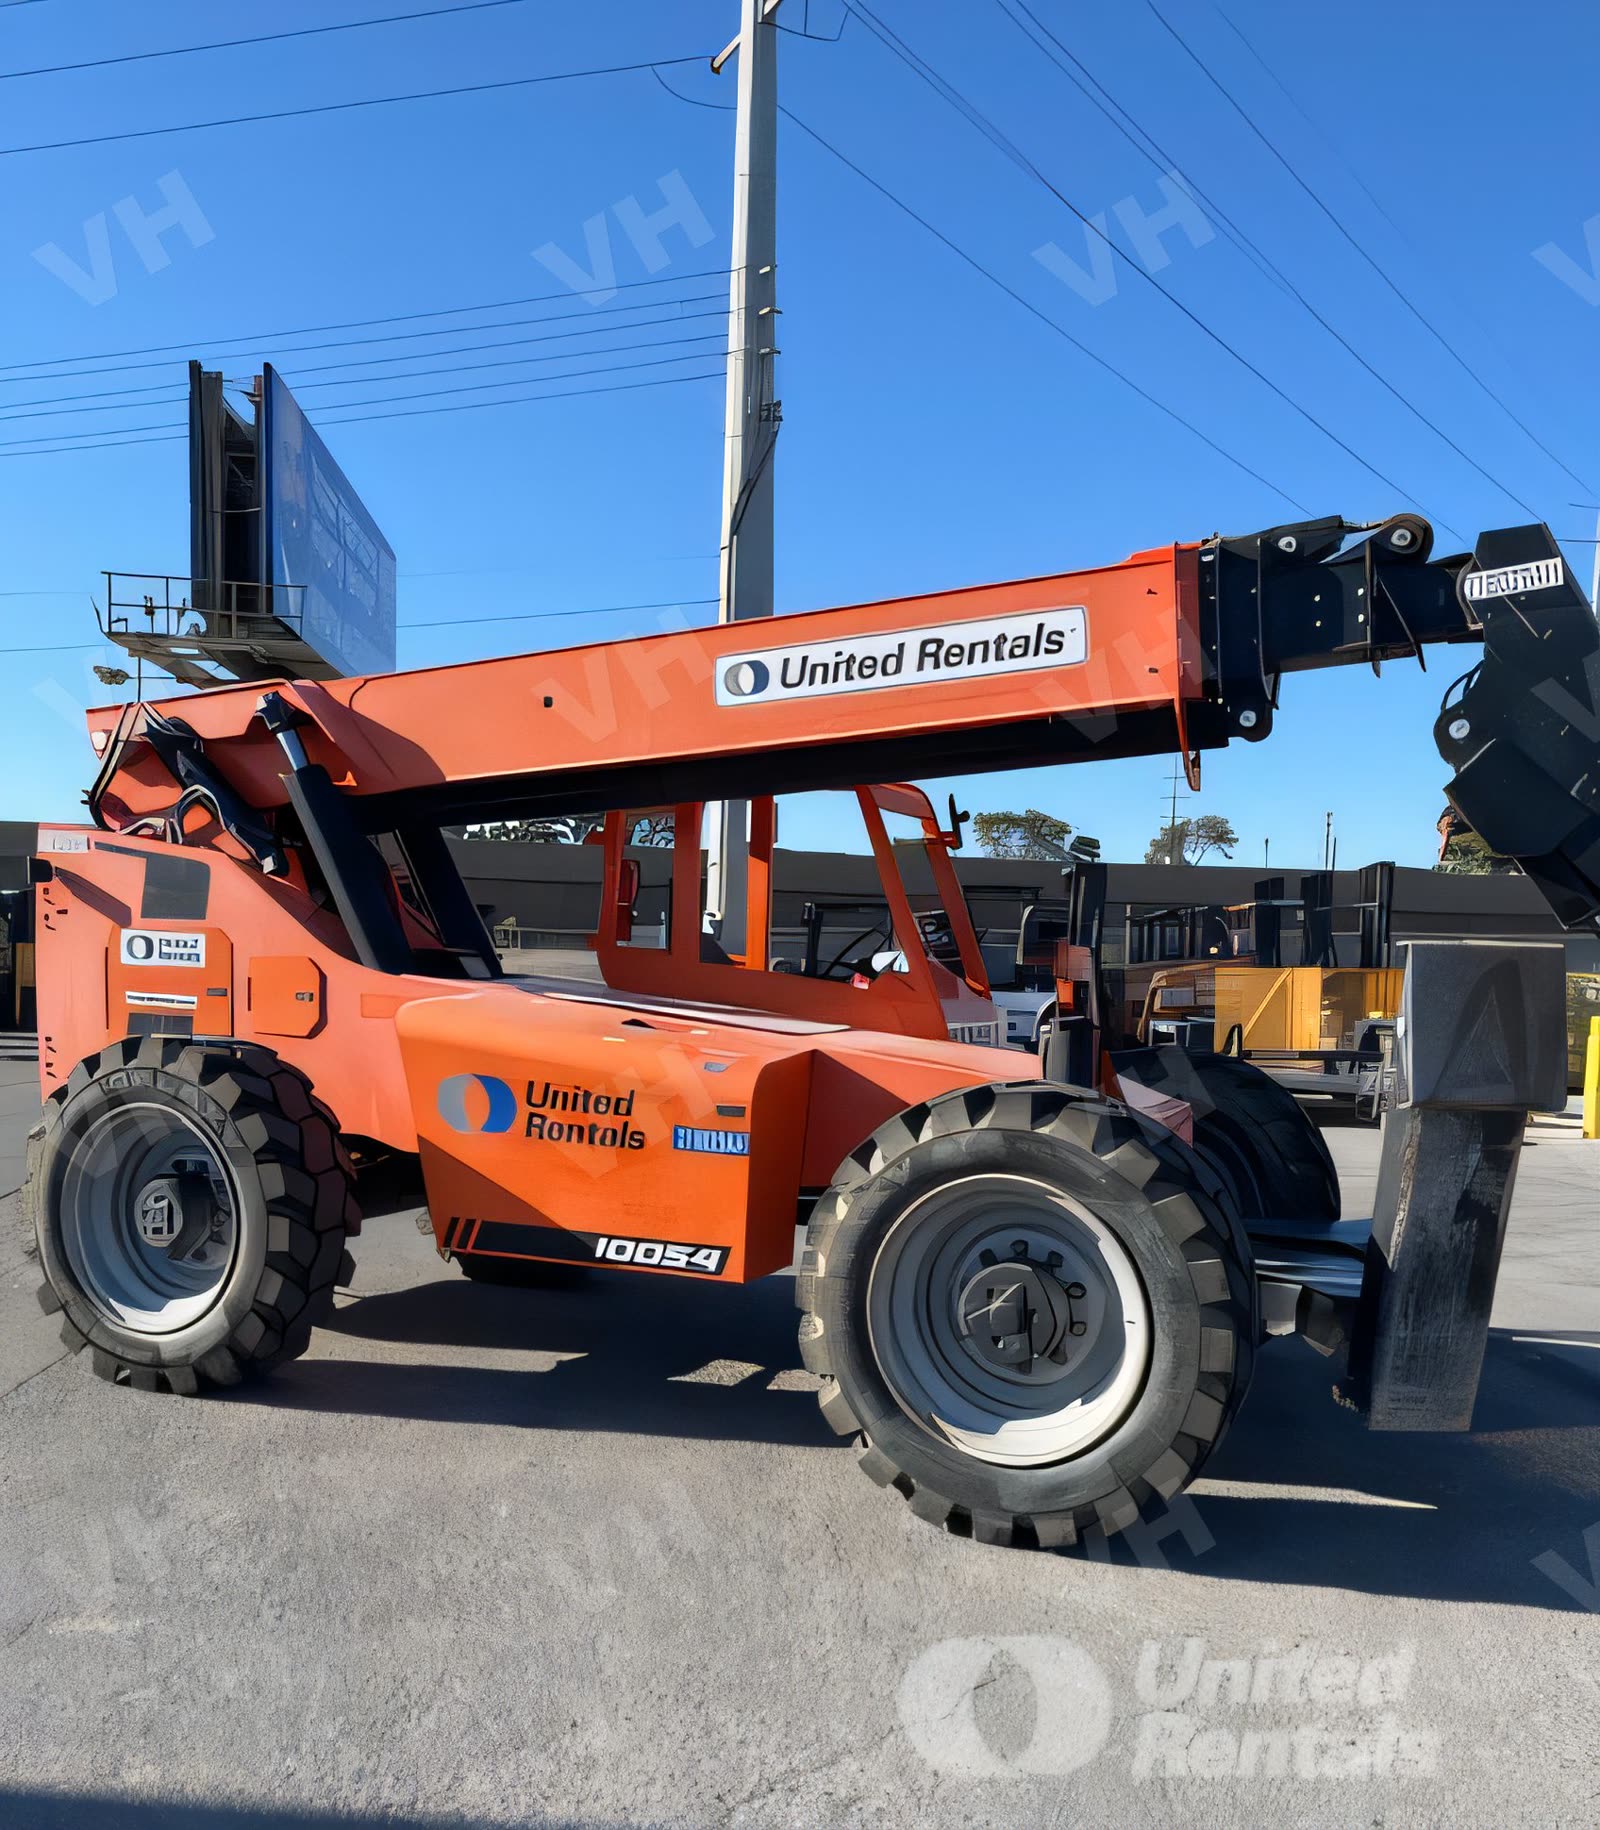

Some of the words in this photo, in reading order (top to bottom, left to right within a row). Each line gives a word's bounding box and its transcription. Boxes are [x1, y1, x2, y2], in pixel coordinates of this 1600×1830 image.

[780, 642, 905, 690] United
[916, 622, 1066, 673] Rentals
[594, 1237, 722, 1273] 10054
